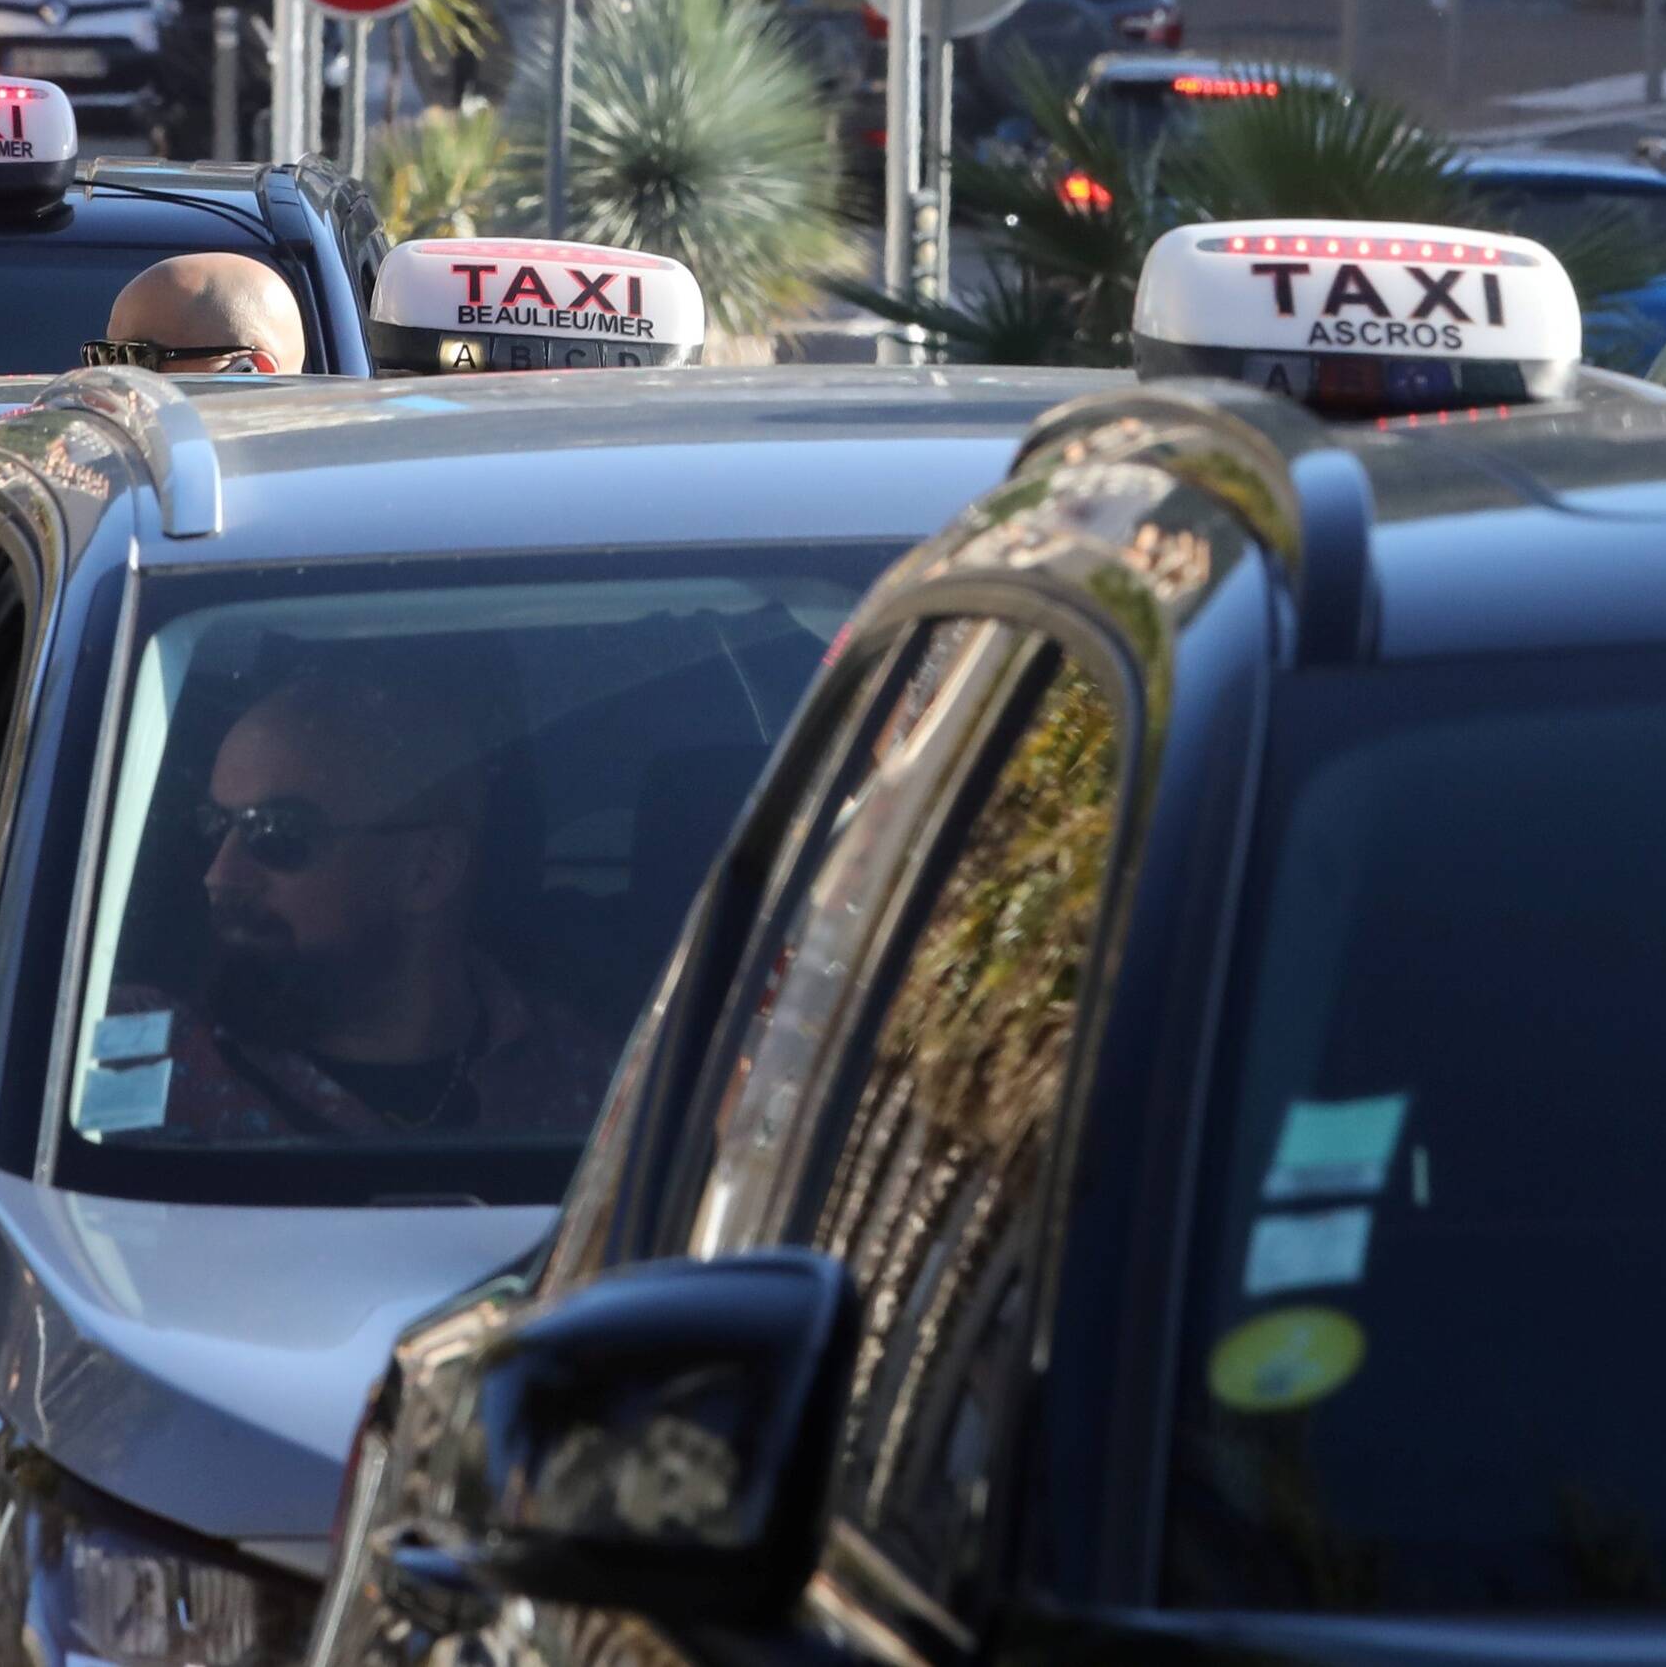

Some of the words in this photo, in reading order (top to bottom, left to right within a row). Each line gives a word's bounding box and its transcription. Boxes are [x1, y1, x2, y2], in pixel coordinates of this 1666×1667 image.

[451, 263, 644, 318] TAXI
[1251, 262, 1506, 327] TAXI
[458, 304, 655, 338] BEAULIEU/MER
[1309, 321, 1464, 350] ASCROS
[452, 344, 477, 369] A
